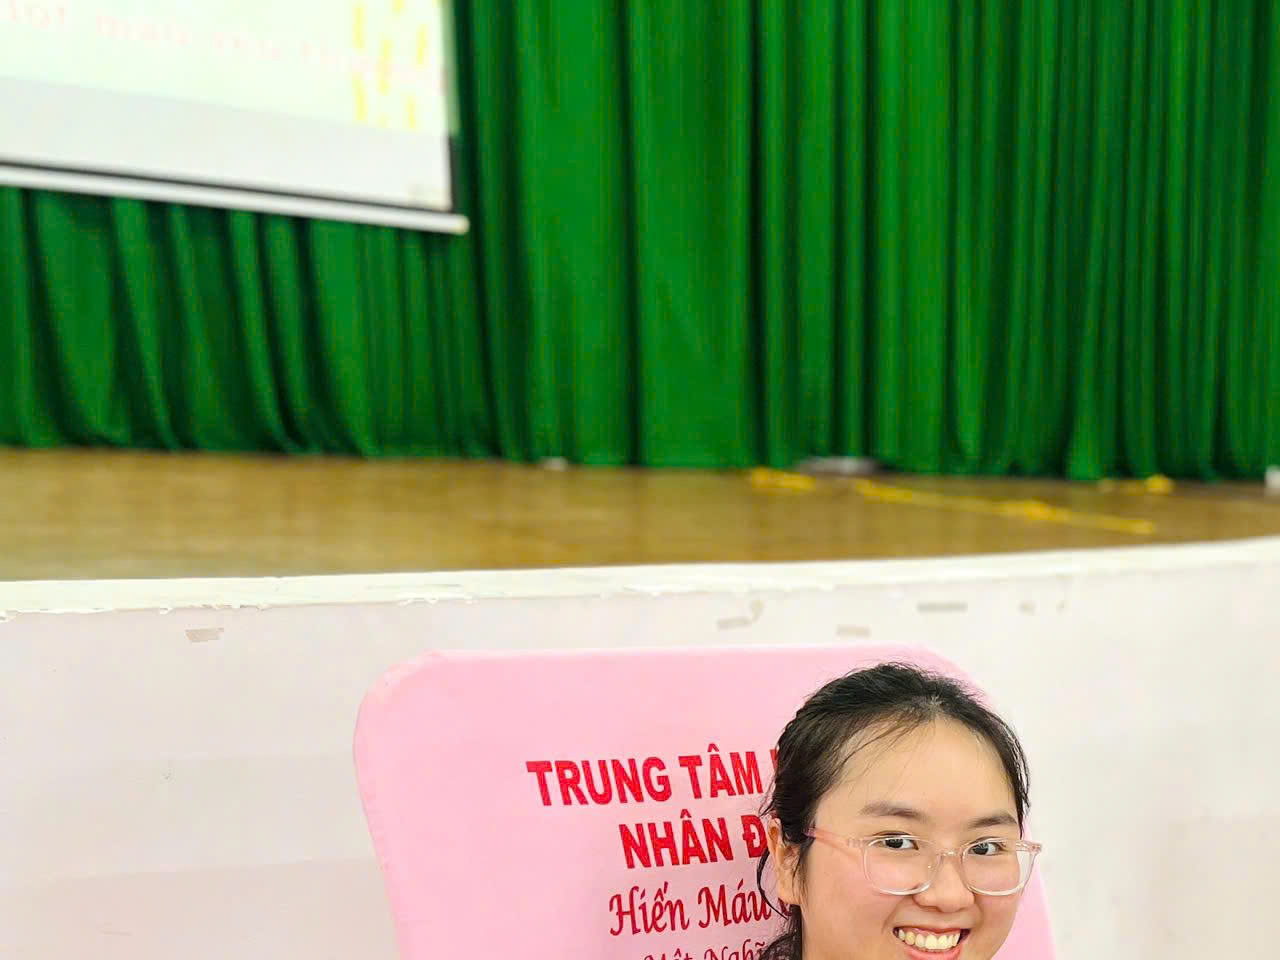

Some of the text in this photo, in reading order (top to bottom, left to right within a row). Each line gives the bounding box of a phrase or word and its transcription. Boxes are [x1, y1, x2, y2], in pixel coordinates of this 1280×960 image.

[525, 743, 763, 807] TRUNG TÂM
[618, 808, 733, 869] NHÂN
[608, 878, 771, 936] Hiến Máu
